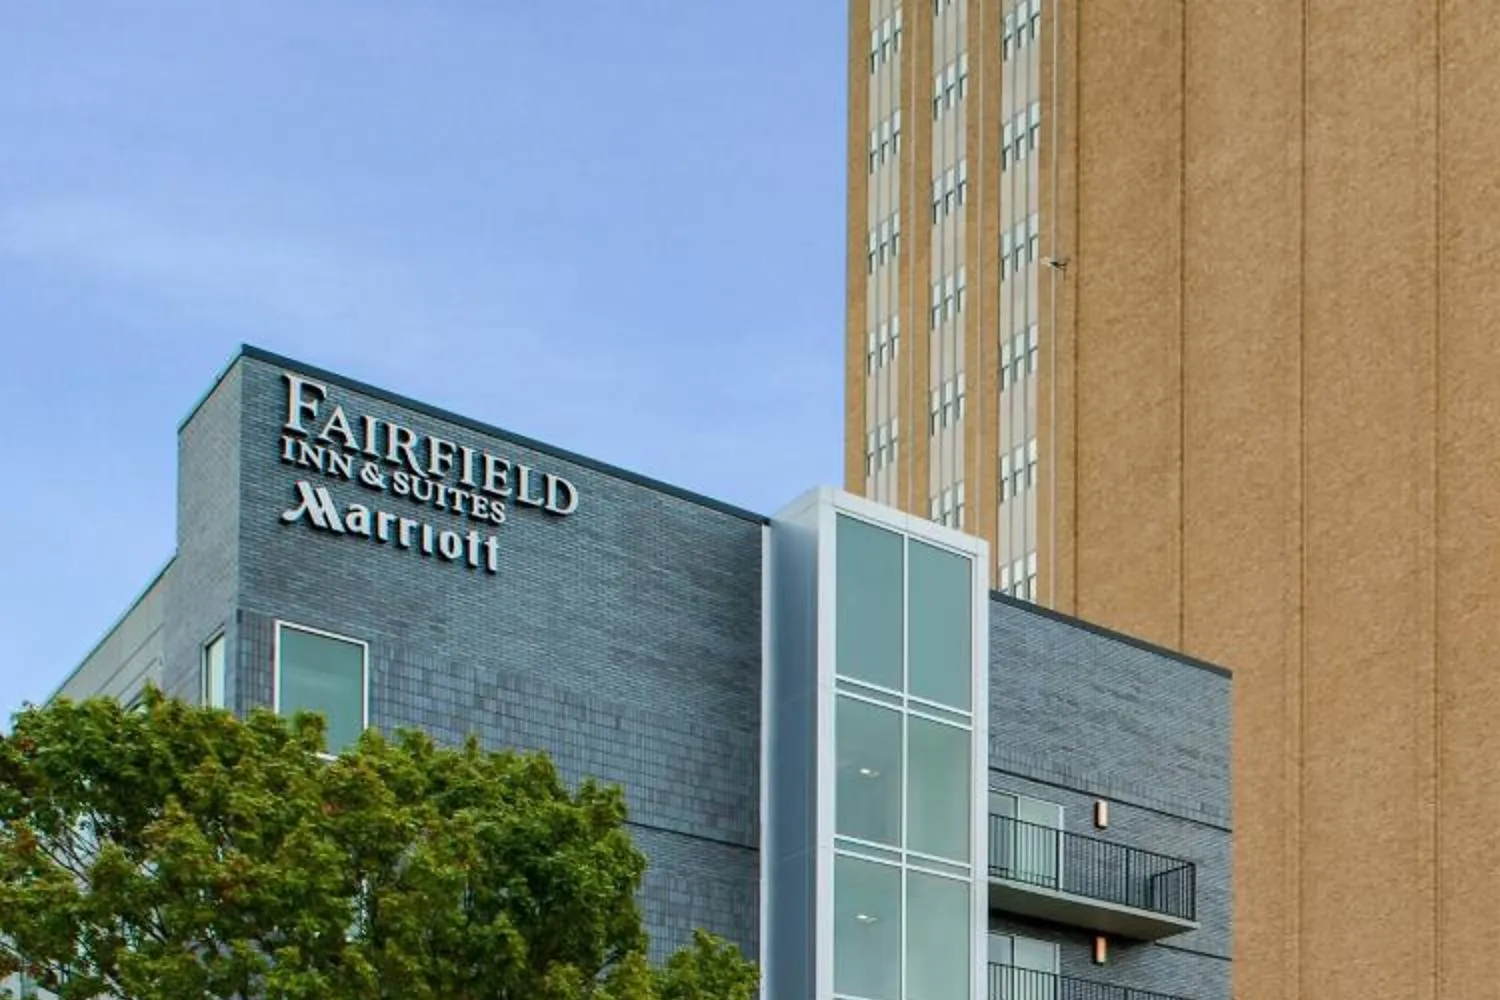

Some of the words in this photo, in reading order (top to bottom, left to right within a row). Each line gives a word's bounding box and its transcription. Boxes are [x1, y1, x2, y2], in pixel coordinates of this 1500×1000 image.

[282, 373, 580, 517] FAIRFIELD
[282, 435, 352, 480] INN
[360, 460, 387, 491] &
[392, 470, 507, 525] SUITES
[281, 480, 500, 574] Marriott
